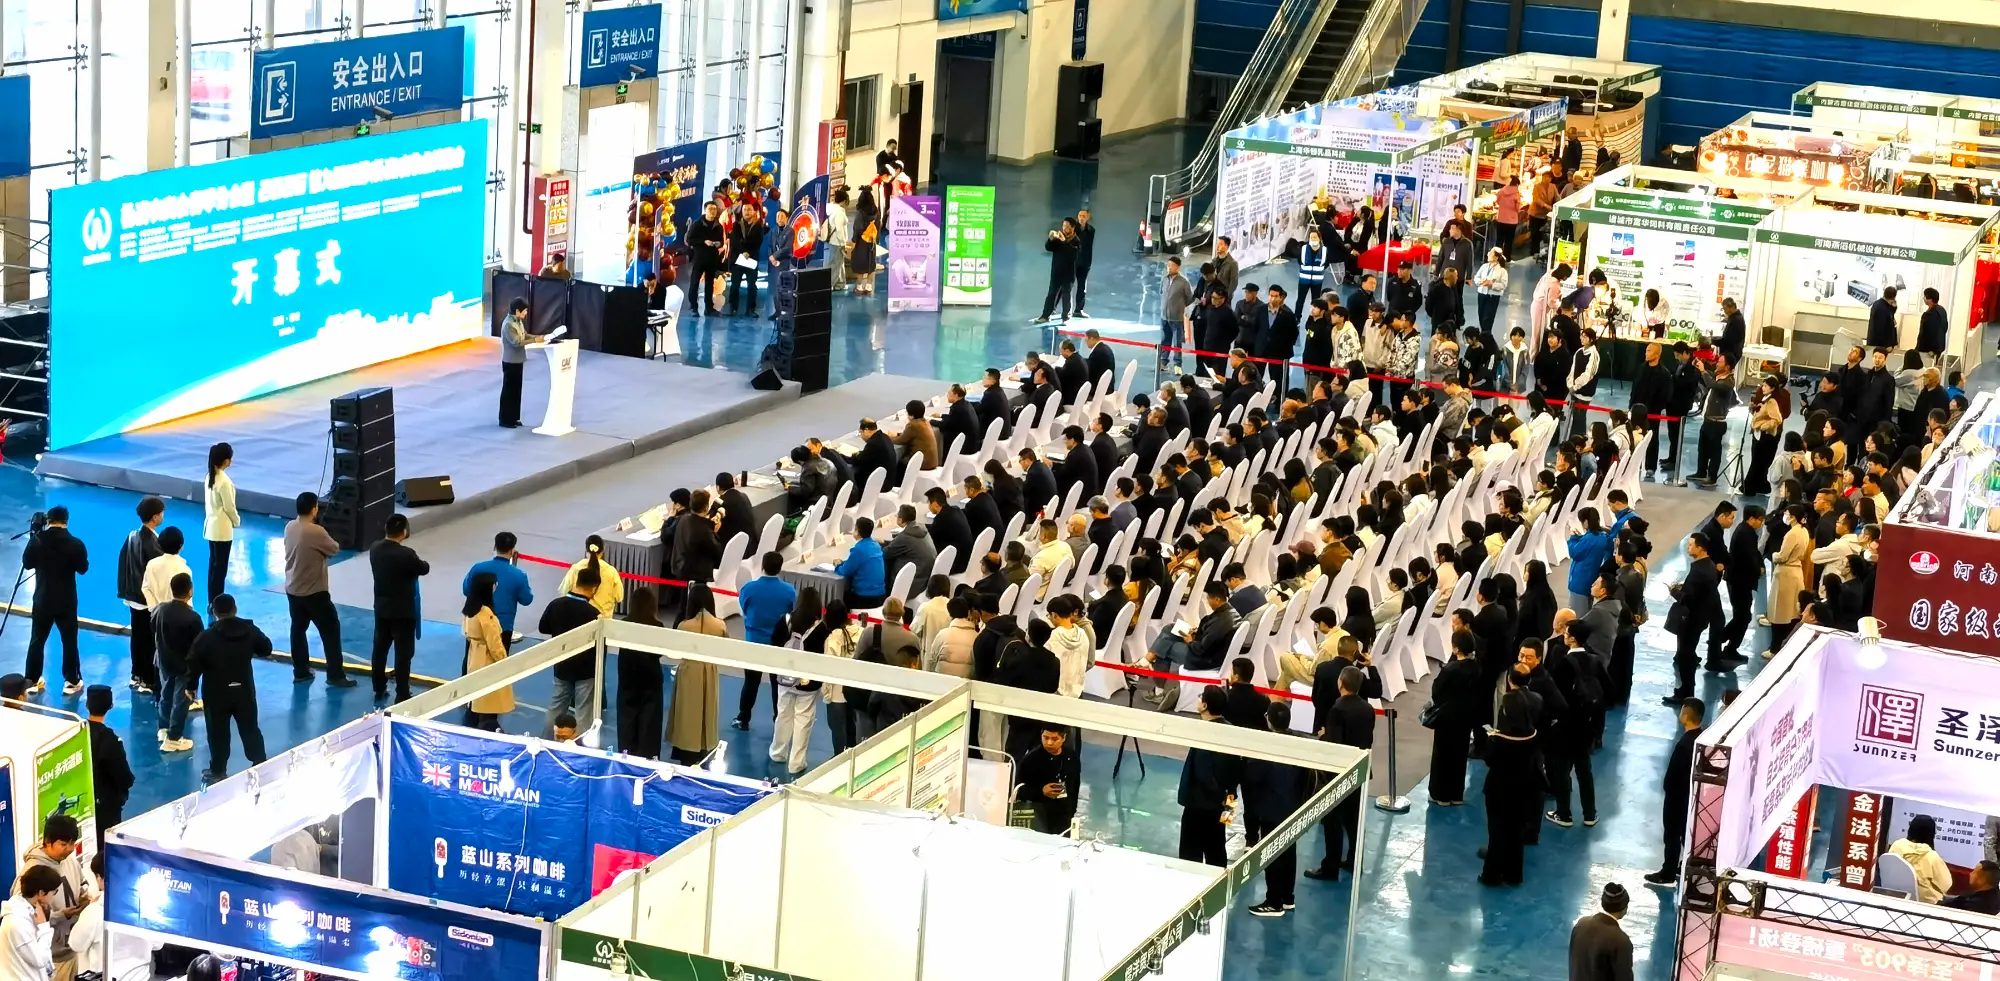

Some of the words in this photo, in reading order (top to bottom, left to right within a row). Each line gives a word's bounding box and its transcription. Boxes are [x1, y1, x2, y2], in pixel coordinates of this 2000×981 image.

[611, 27, 655, 48] 安全出入口
[332, 51, 423, 90] 安全出入口
[331, 89, 391, 112] ENTRANCE
[398, 84, 422, 100] EXIT
[1744, 152, 1844, 183] 印尼猫咖
[1953, 560, 1998, 585] 河南
[1935, 706, 2000, 744] 圣泽
[459, 763, 498, 782] BLUE
[1845, 793, 1875, 885] 金法系曾
[461, 844, 566, 881] 蓝山系列咖啡
[243, 898, 351, 934] 蓝山列咖啡
